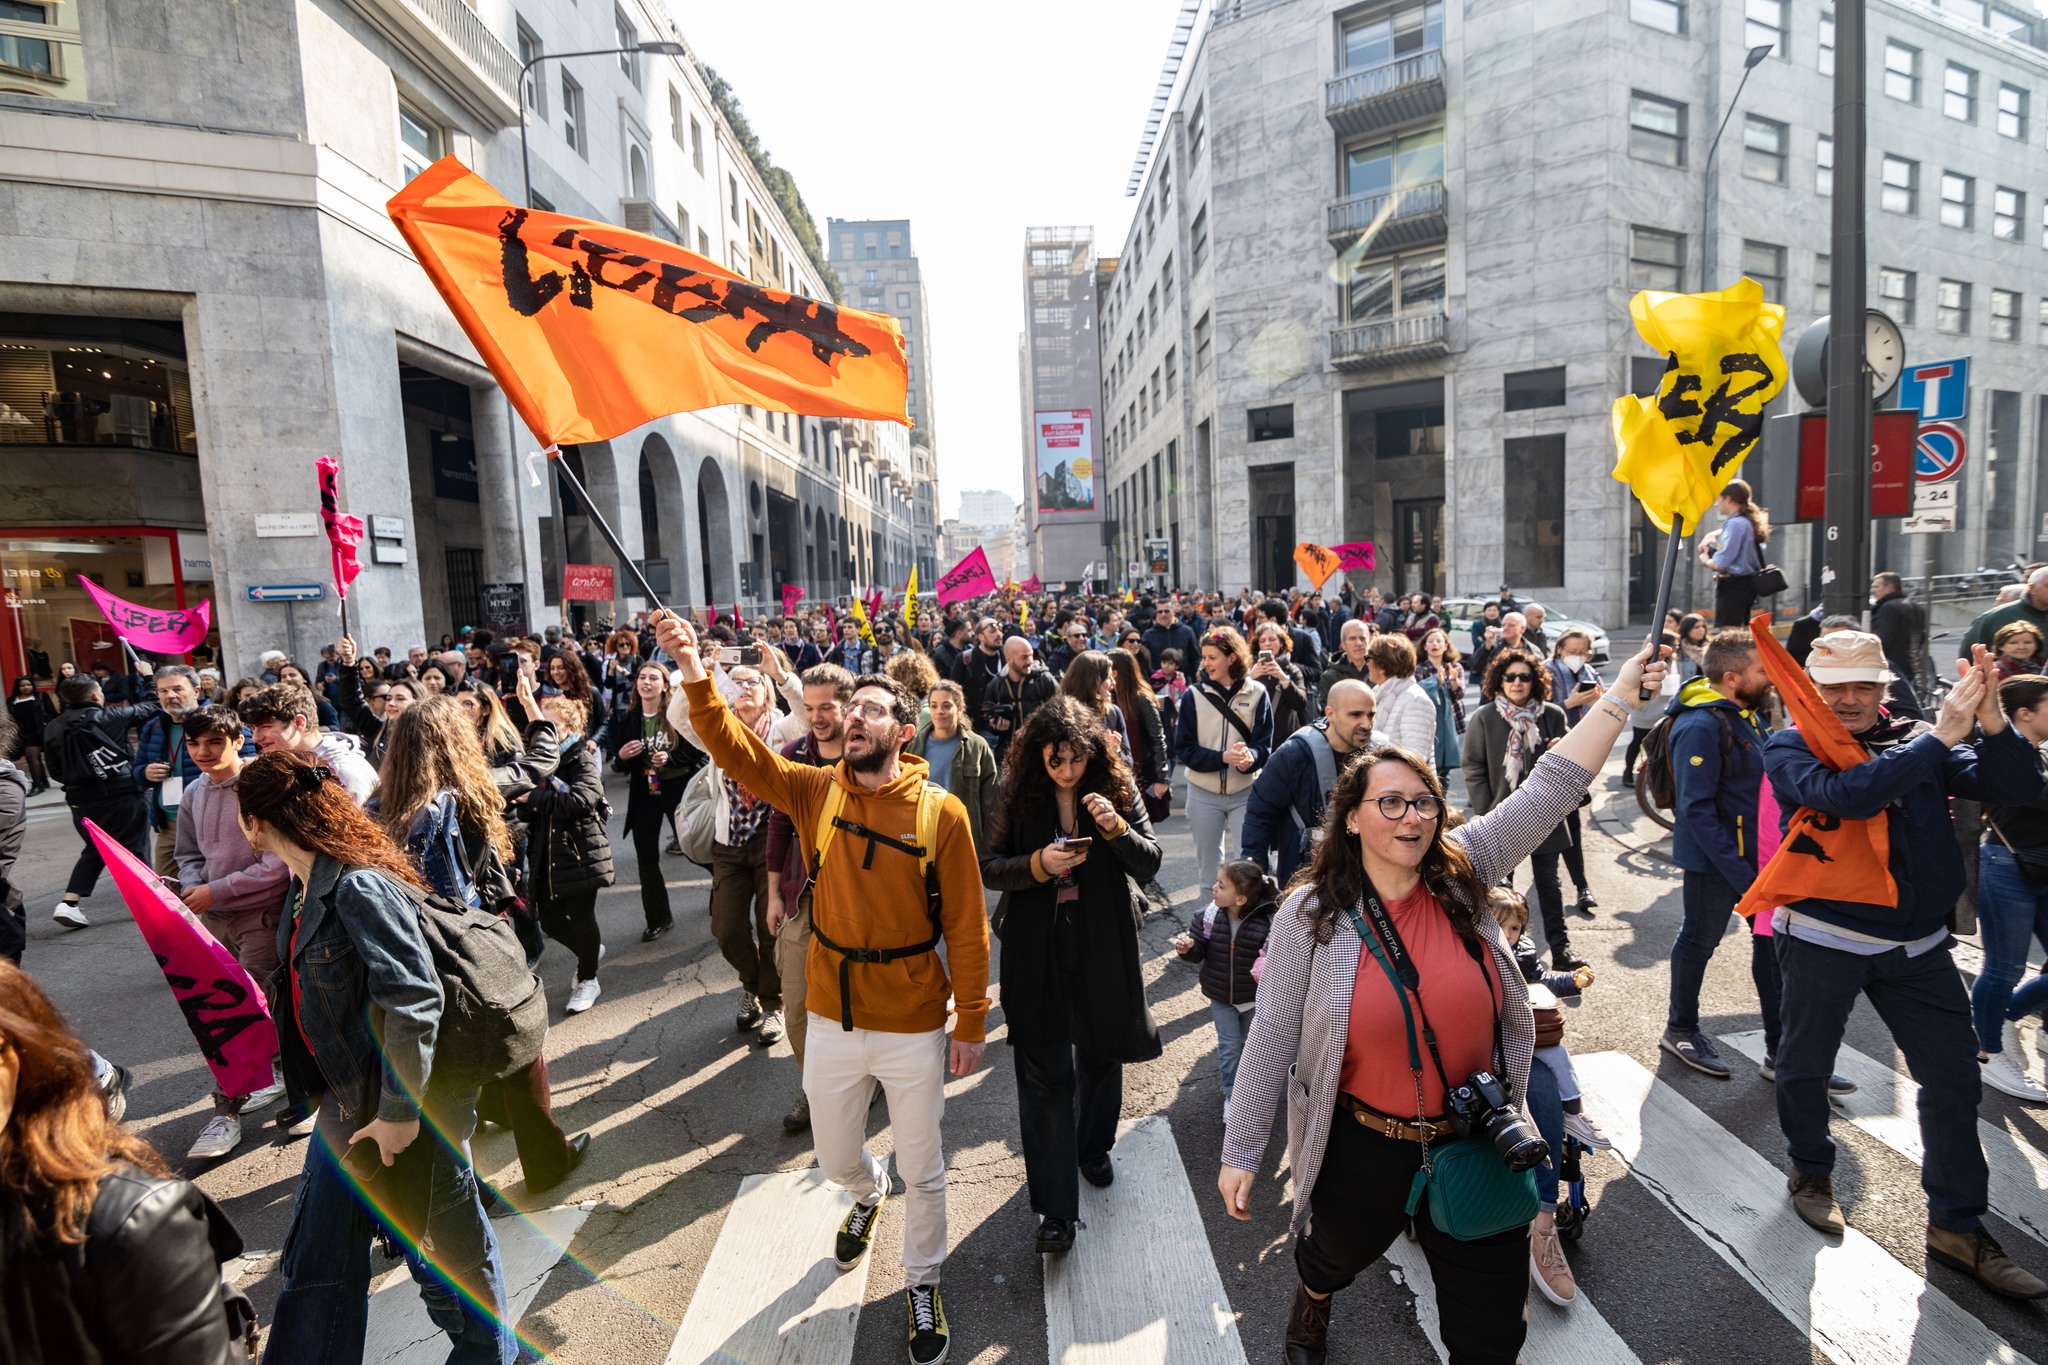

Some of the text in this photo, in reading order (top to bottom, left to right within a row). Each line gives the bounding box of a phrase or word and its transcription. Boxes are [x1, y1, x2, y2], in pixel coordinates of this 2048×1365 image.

[1929, 490, 1949, 501] 24
[1827, 526, 1839, 541] 6
[1368, 897, 1401, 959] EOS DIGITAL
